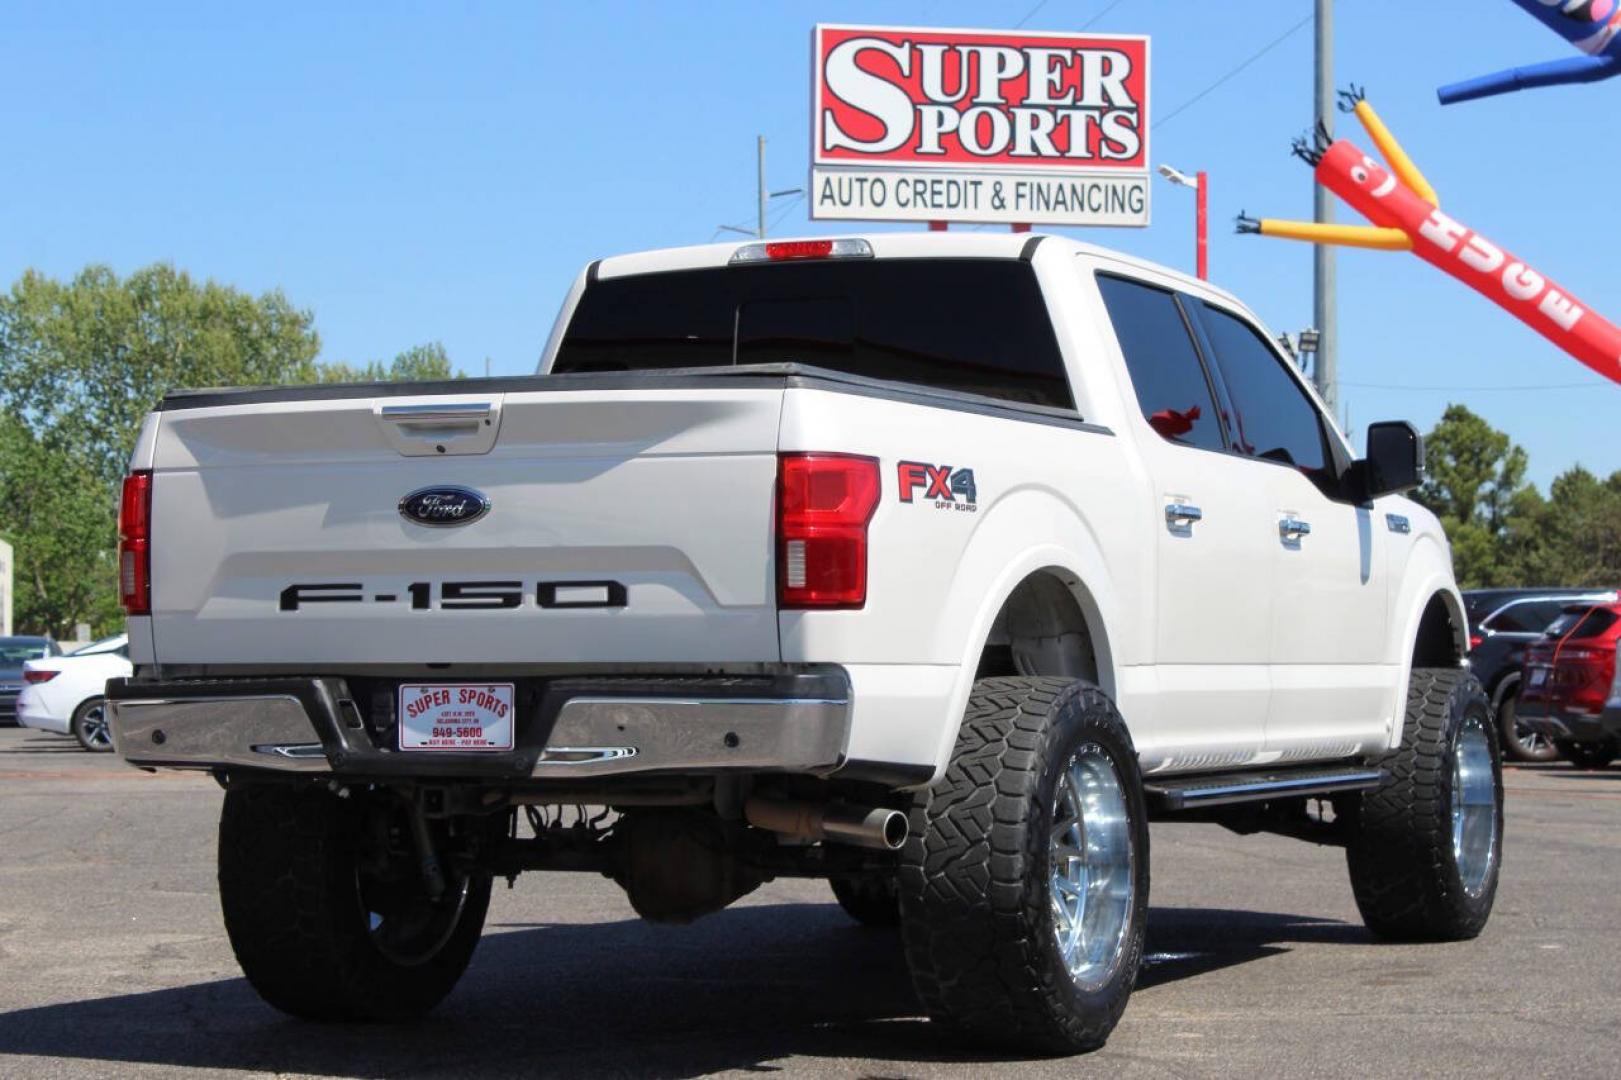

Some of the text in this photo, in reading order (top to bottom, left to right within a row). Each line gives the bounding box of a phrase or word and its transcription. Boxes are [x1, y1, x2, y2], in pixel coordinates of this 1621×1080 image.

[820, 177, 1145, 214] AUTO CREDIT & FINANCING
[1418, 209, 1584, 331] HUGE
[897, 460, 977, 504] FX4
[418, 494, 467, 518] Ford
[935, 501, 977, 513] OFF ROAD
[280, 580, 628, 611] F-150
[407, 688, 509, 718] SUPER SPORTS
[432, 727, 483, 738] 949-5600
